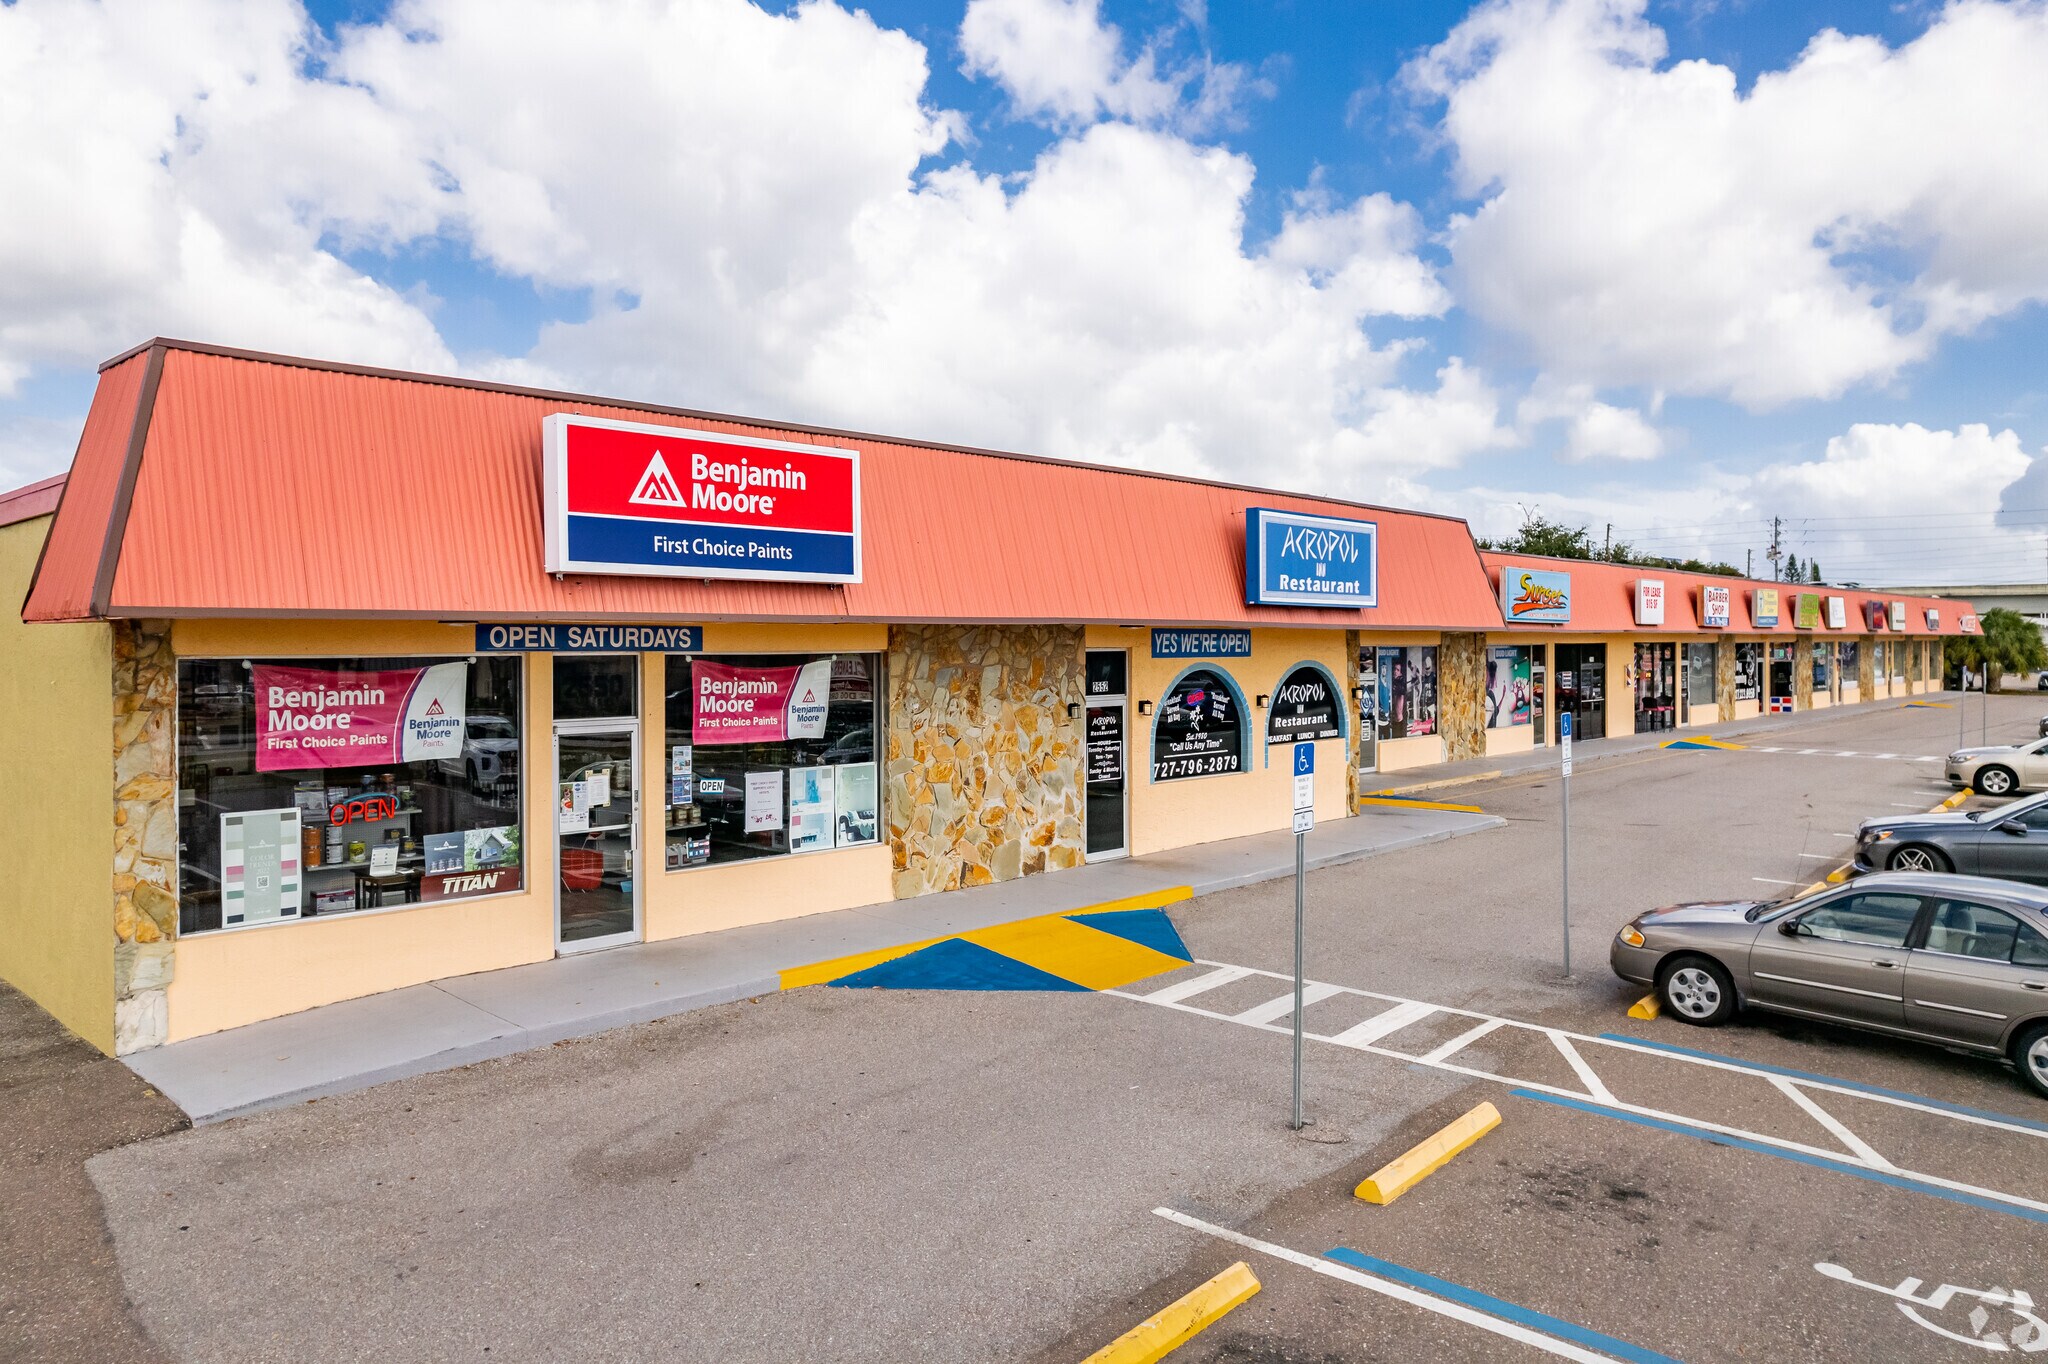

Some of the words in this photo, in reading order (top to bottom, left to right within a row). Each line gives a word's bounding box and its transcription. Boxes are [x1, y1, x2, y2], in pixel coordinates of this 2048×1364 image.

[692, 454, 806, 491] Benjamin
[692, 483, 774, 514] Moore
[654, 536, 688, 554] First
[692, 538, 744, 557] Choice
[748, 542, 792, 560] Paints
[1281, 526, 1358, 563] ACROPOL
[1280, 574, 1360, 594] Restaurant
[1514, 574, 1567, 604] Sunset
[1650, 587, 1662, 598] LEASE
[1708, 590, 1728, 603] BARBER
[1712, 604, 1724, 615] SHOP
[490, 626, 555, 648] OPEN
[568, 626, 692, 648] SATURDAYS
[1154, 634, 1177, 653] YES
[1180, 634, 1217, 652] WE'RE
[1220, 633, 1250, 652] OPEN
[1506, 649, 1517, 657] LIGHT
[700, 676, 778, 698] Benjamin
[1093, 682, 1108, 692] 2552
[1278, 683, 1325, 704] ACROPOL
[268, 684, 385, 712] Benjamin
[700, 696, 754, 714] Moore
[791, 704, 825, 716] Benjamin
[797, 714, 820, 722] Moore
[268, 709, 350, 732] Moore
[410, 716, 460, 732] Benjamin
[699, 717, 720, 728] First
[722, 716, 751, 727] Choice
[753, 715, 778, 726] Paints
[1275, 714, 1327, 727] Restaurant
[268, 737, 298, 750] First
[302, 736, 346, 748] Choice
[350, 734, 388, 746] Paints
[416, 728, 450, 740] Moore
[1268, 734, 1292, 742] REAKFAST
[1320, 729, 1338, 738] DINNER
[422, 739, 444, 748] Paints
[1193, 741, 1205, 750] Any
[1154, 755, 1238, 778] 727-796-2879
[702, 781, 723, 791] OPEN
[330, 798, 396, 826] OPEN
